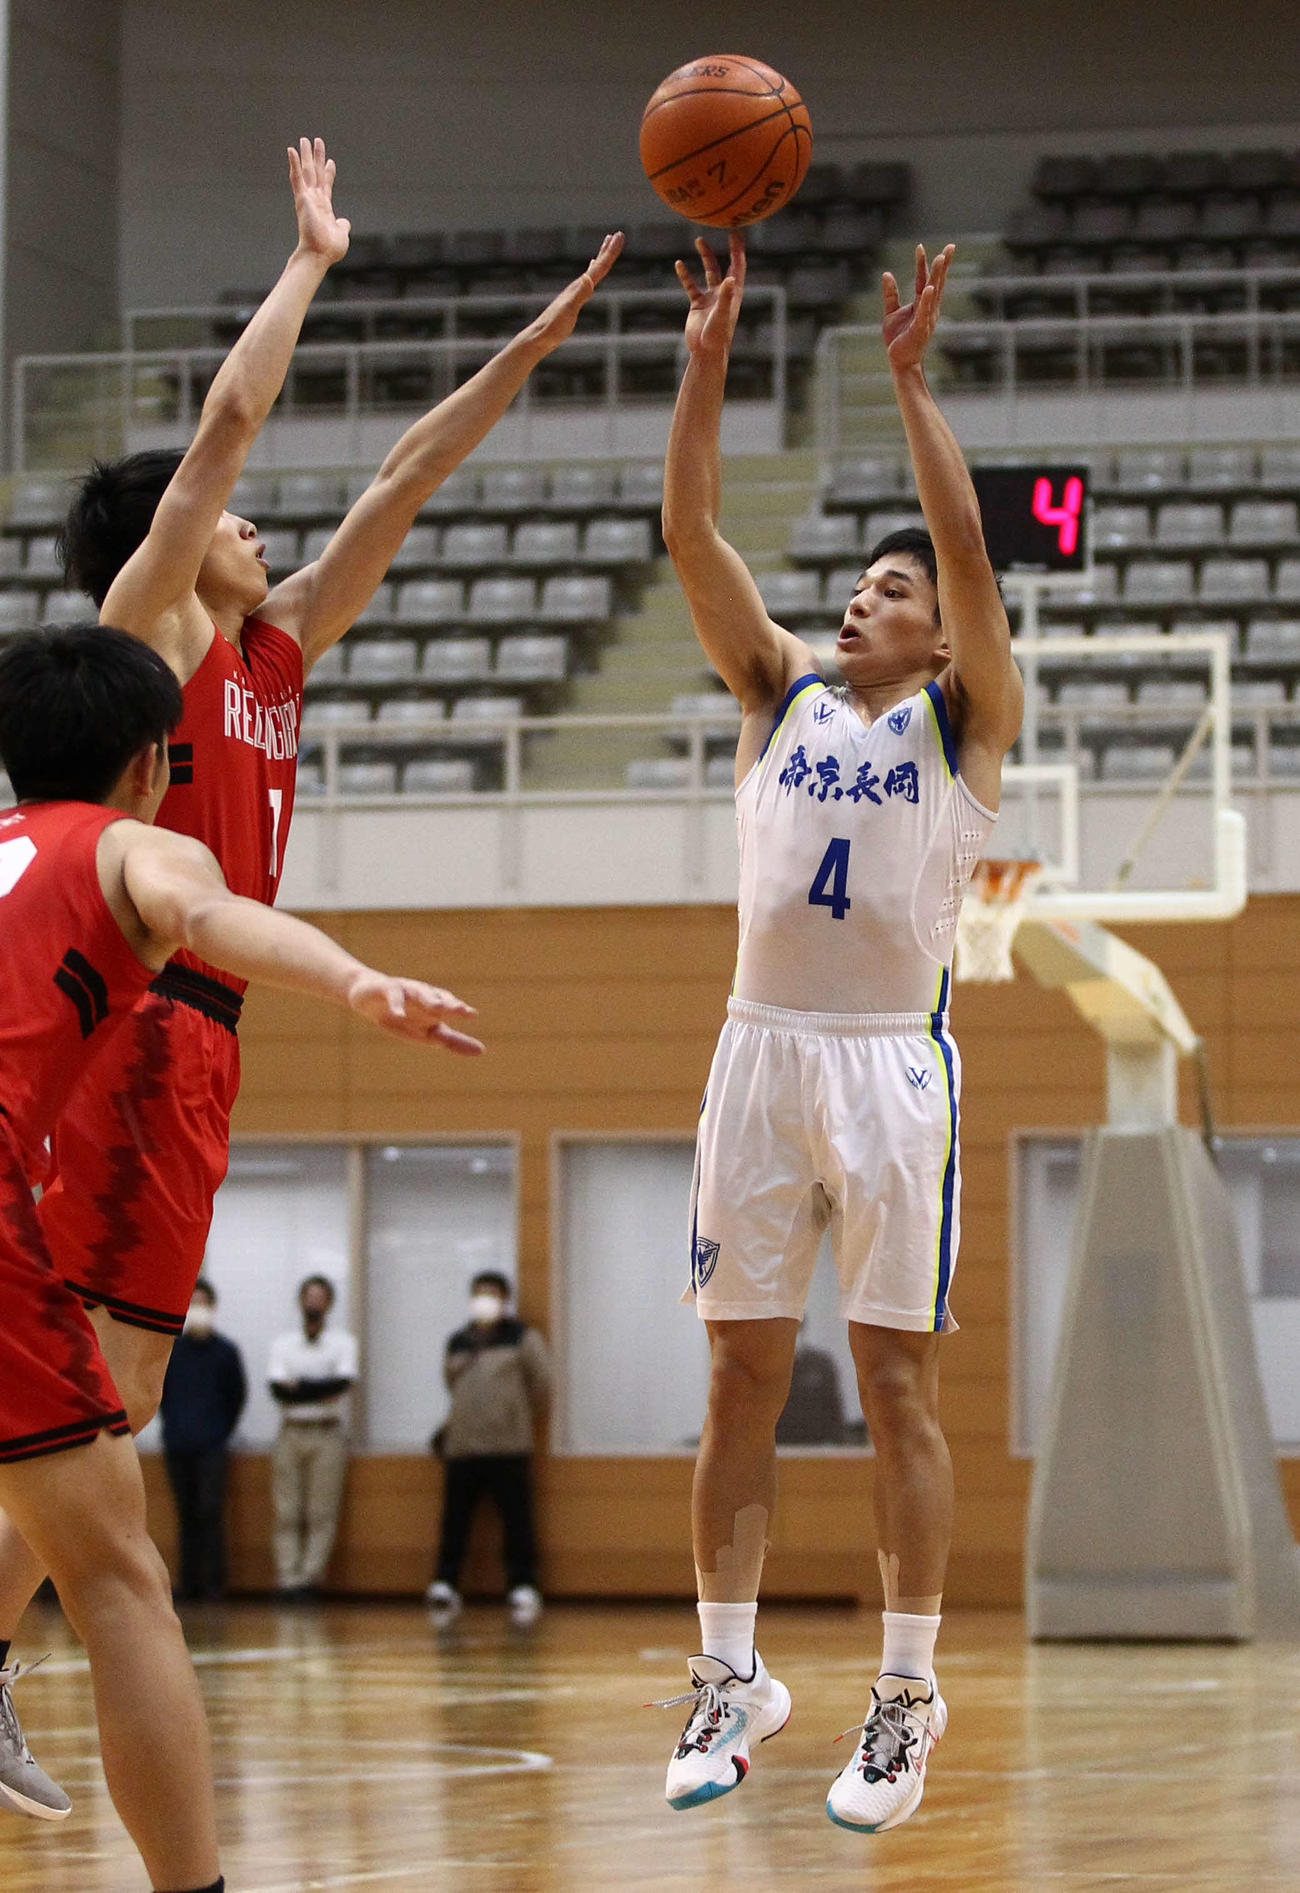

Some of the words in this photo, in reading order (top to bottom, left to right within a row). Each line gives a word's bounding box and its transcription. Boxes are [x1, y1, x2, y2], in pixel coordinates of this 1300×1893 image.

[1031, 476, 1083, 556] 4
[779, 745, 919, 806] 帝京長岡
[808, 837, 851, 920] 4
